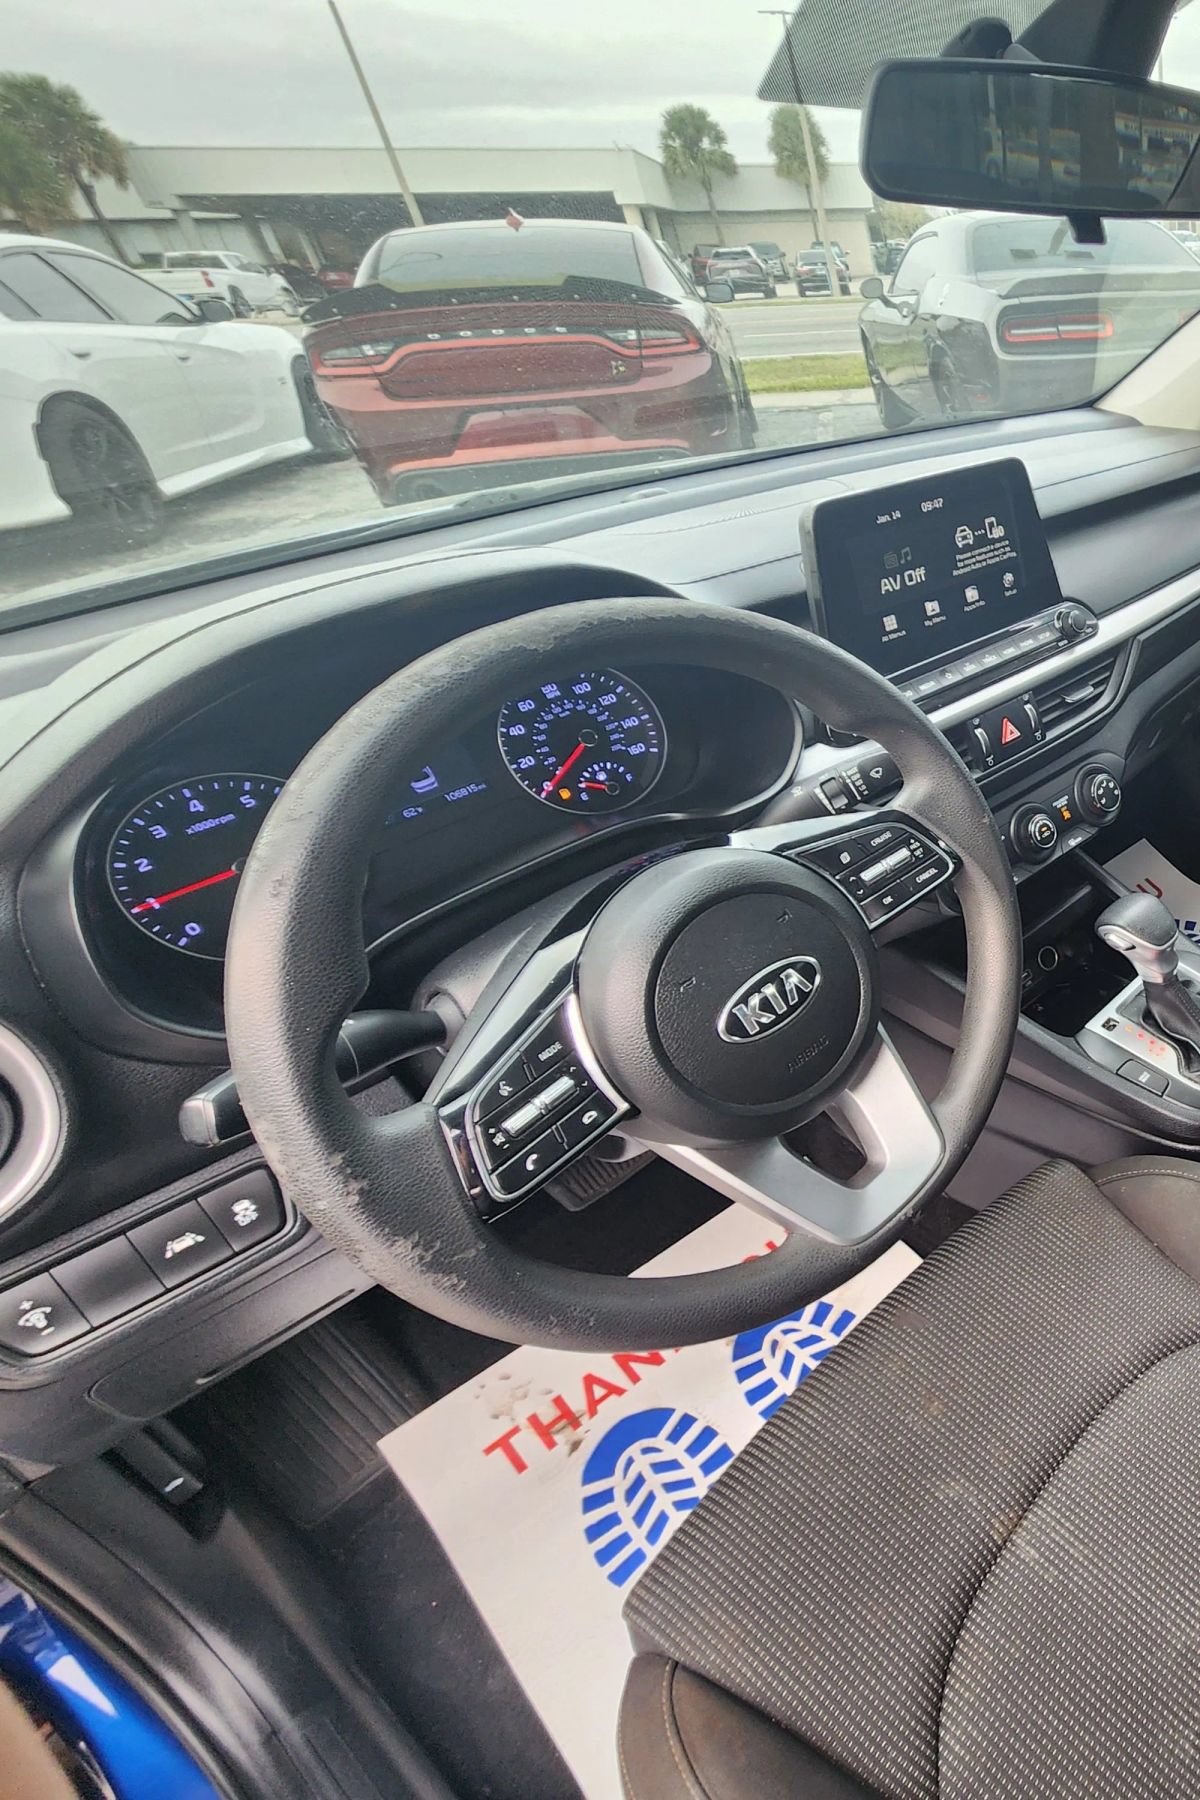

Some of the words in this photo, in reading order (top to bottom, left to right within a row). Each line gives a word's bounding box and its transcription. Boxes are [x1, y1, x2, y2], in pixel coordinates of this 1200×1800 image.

[921, 498, 944, 512] 09:47
[880, 574, 901, 594] AV
[904, 566, 926, 586] Off
[571, 682, 592, 695] 100
[517, 699, 535, 712] 60
[598, 693, 617, 706] 120
[620, 716, 639, 729] 140
[508, 724, 526, 736] 40
[627, 742, 646, 756] 160
[517, 755, 535, 769] 20
[625, 773, 634, 782] F
[239, 794, 256, 808] 5
[579, 791, 589, 801] E
[189, 799, 205, 813] 4
[185, 813, 236, 835] x1000rpm
[148, 825, 168, 839] 3
[870, 831, 892, 846] CRUISE
[134, 858, 153, 872] 2
[915, 867, 939, 883] CANCEL
[882, 896, 894, 905] OK
[184, 922, 201, 936] 0
[732, 967, 814, 1036] KIA
[537, 1041, 564, 1062] MODE
[483, 1346, 682, 1475] THAN
